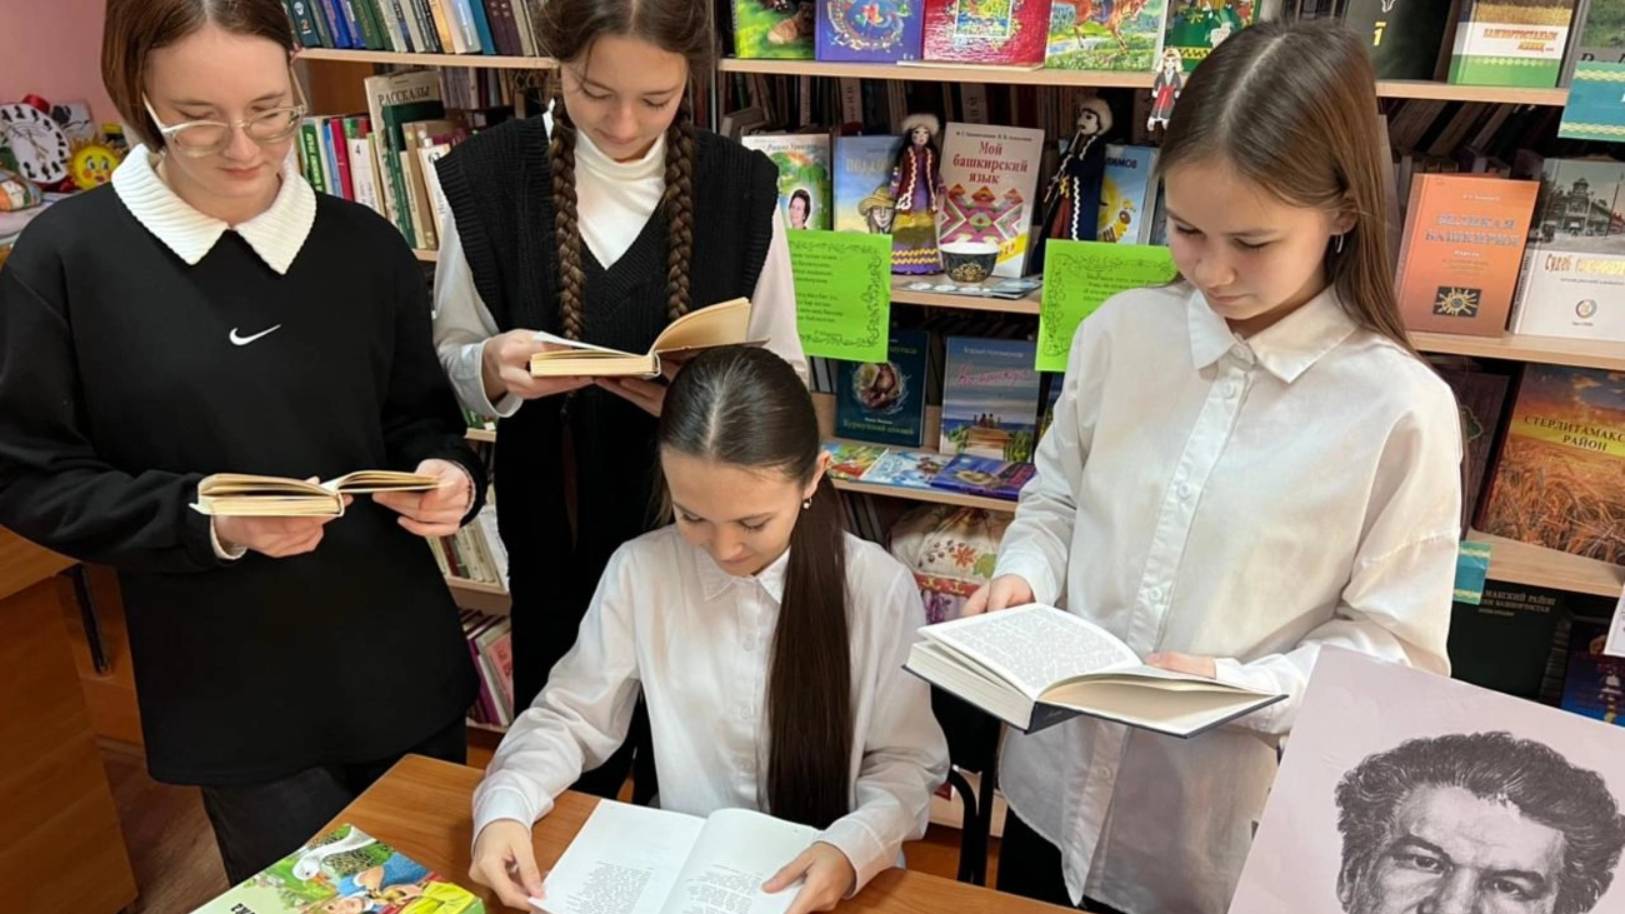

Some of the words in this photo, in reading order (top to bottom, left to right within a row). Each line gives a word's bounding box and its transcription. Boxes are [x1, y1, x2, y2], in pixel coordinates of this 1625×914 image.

[377, 85, 431, 105] РАССКАЗЫ
[979, 141, 1002, 155] Мой
[953, 153, 1028, 173] башкирский
[969, 173, 1000, 184] язык
[1562, 434, 1608, 451] РАЙОН
